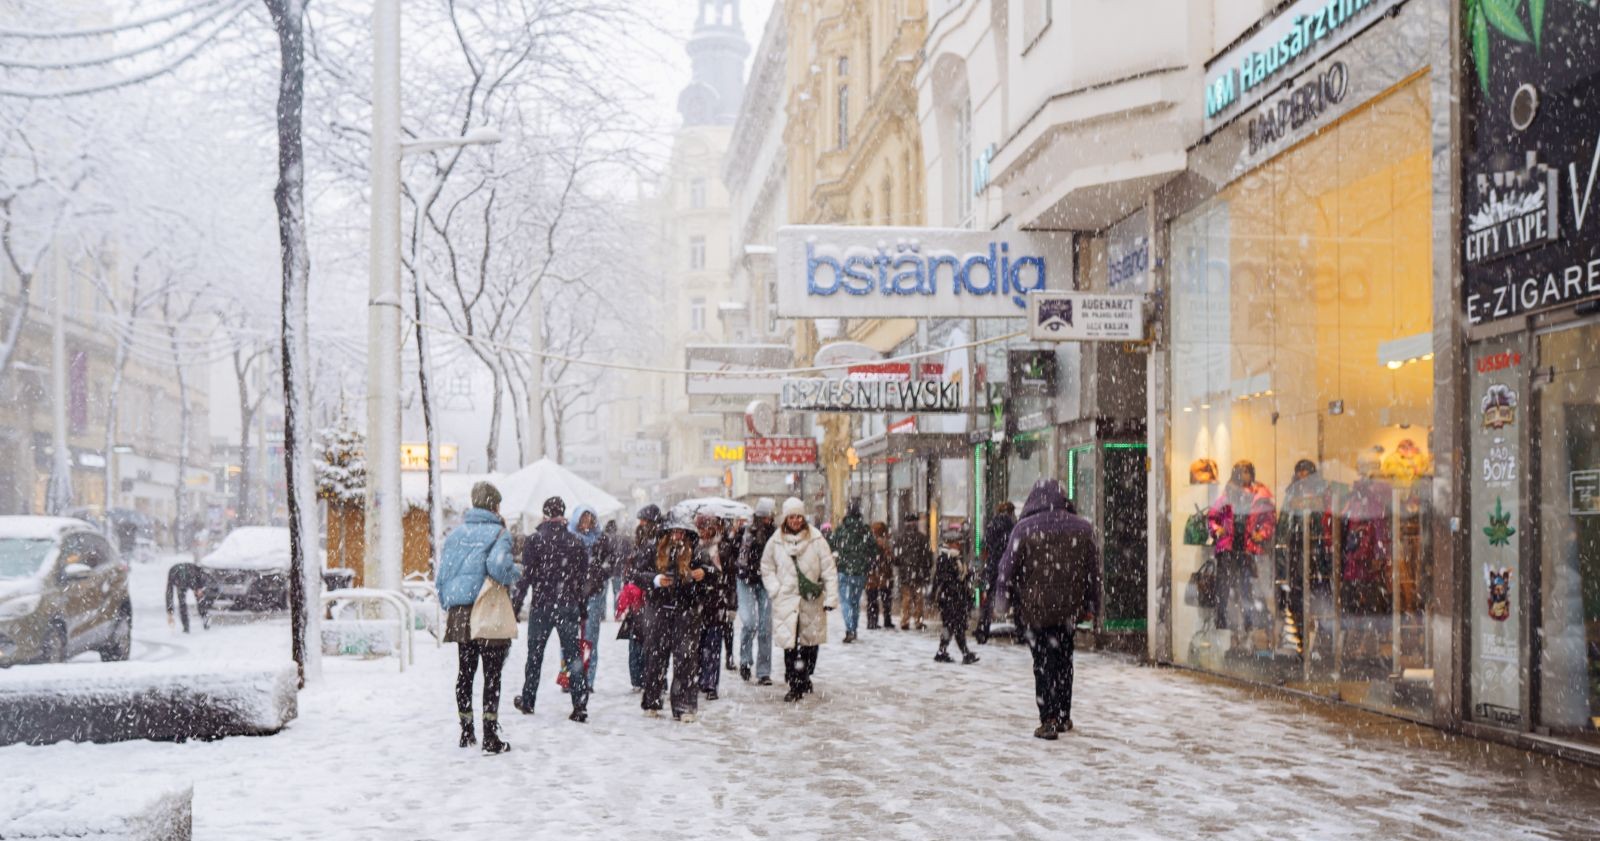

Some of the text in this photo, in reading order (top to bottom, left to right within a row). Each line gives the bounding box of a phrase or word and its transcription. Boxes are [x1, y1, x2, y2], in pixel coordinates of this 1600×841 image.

[1248, 61, 1349, 156] IMPERIO
[1466, 209, 1547, 262] CITY VAPE
[806, 237, 1047, 309] bständig
[1467, 257, 1600, 324] E-ZIGARE
[1081, 298, 1134, 310] AUGENARZT
[1483, 456, 1516, 481] BOYZ
